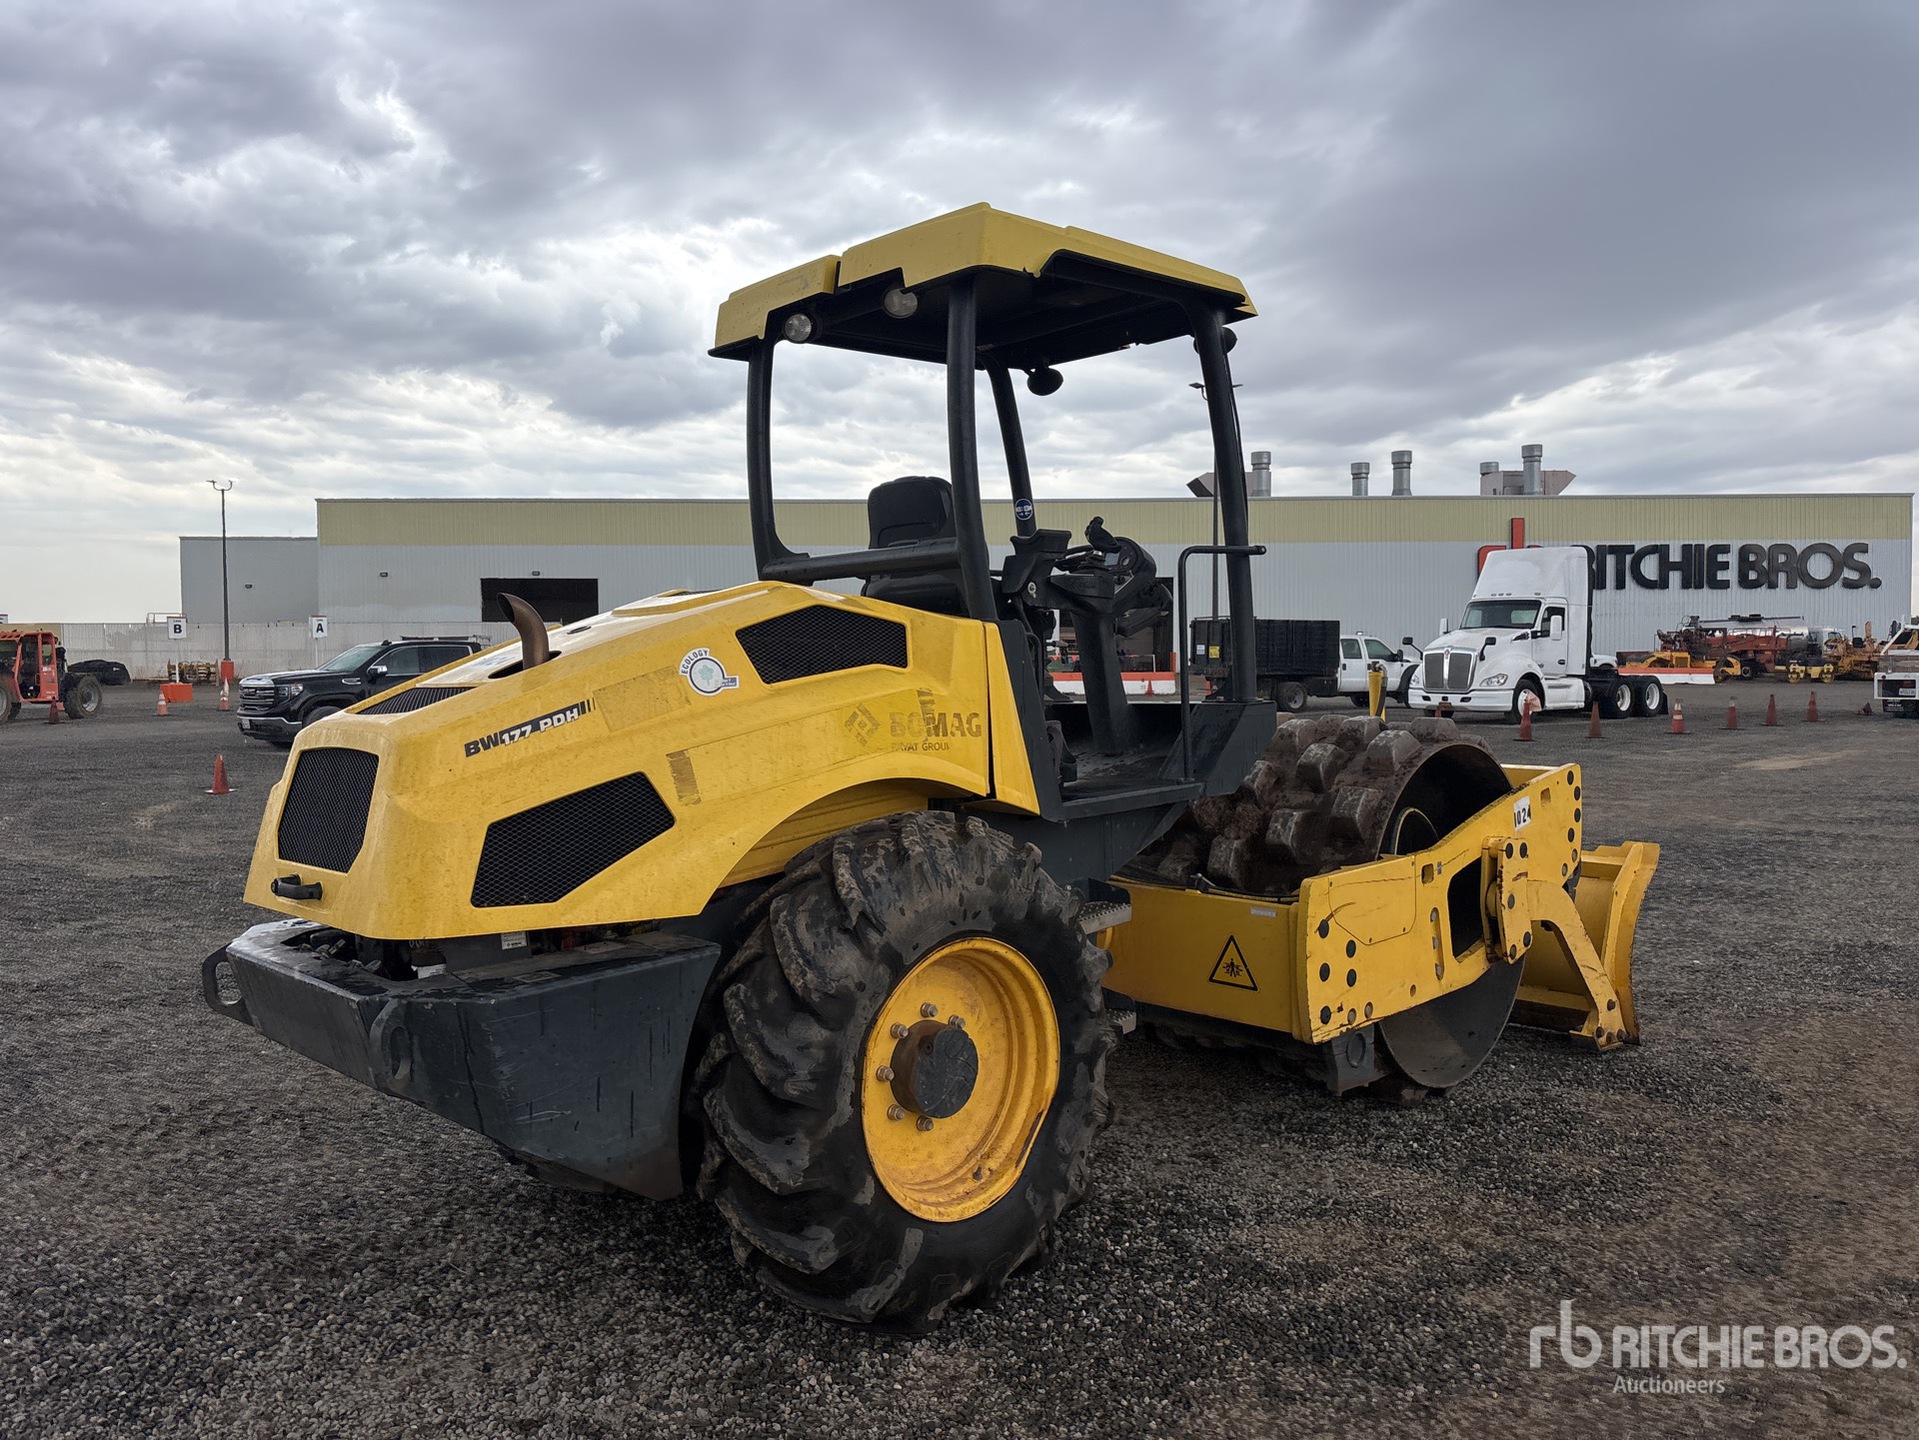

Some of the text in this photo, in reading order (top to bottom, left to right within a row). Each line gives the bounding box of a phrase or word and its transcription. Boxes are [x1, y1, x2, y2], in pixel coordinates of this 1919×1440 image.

[1738, 542, 1882, 590] BROS.
[173, 624, 182, 634] B
[316, 623, 324, 633] A
[681, 649, 708, 675] ECOLOGY
[539, 707, 580, 732] PDH
